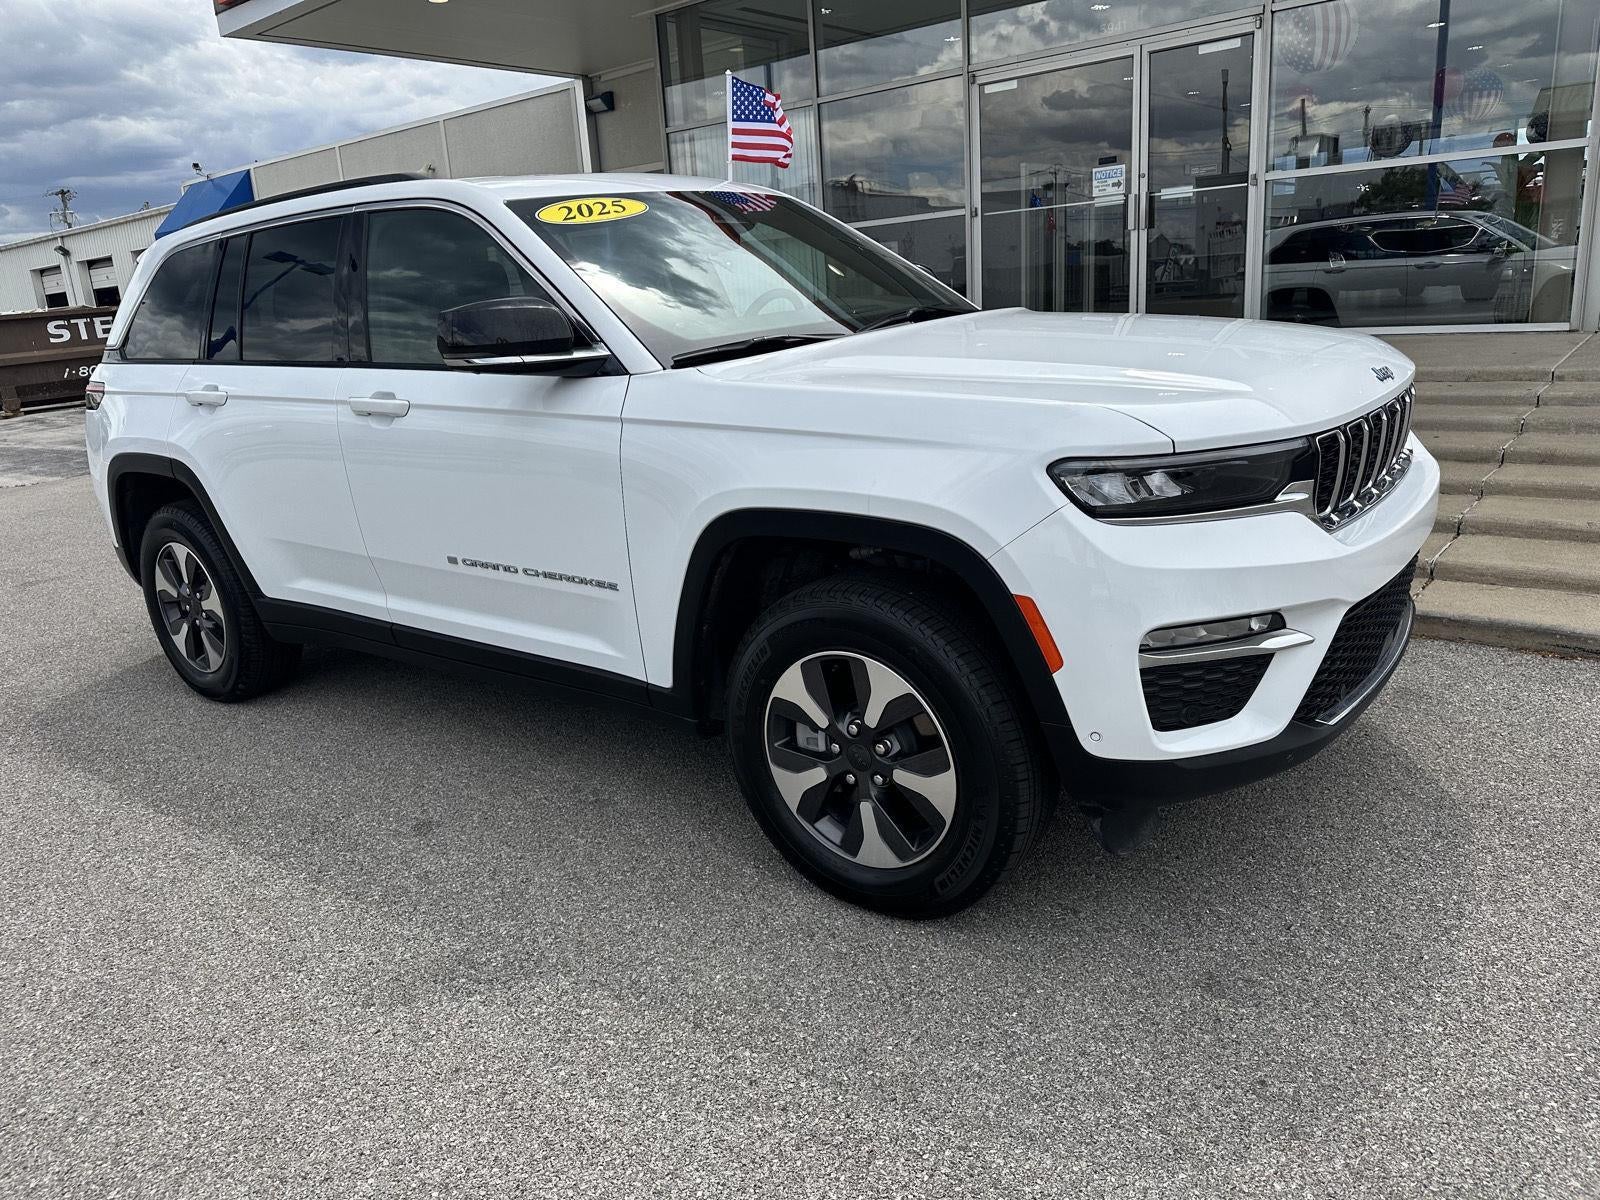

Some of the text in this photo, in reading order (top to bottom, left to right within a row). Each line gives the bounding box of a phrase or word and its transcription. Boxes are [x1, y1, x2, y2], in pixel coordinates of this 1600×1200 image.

[1095, 168, 1122, 180] NOTICE
[558, 200, 626, 221] 2025
[1371, 366, 1394, 381] Jeep
[461, 558, 620, 592] GRAND CHEROKEE
[935, 813, 988, 895] MICHELIN
